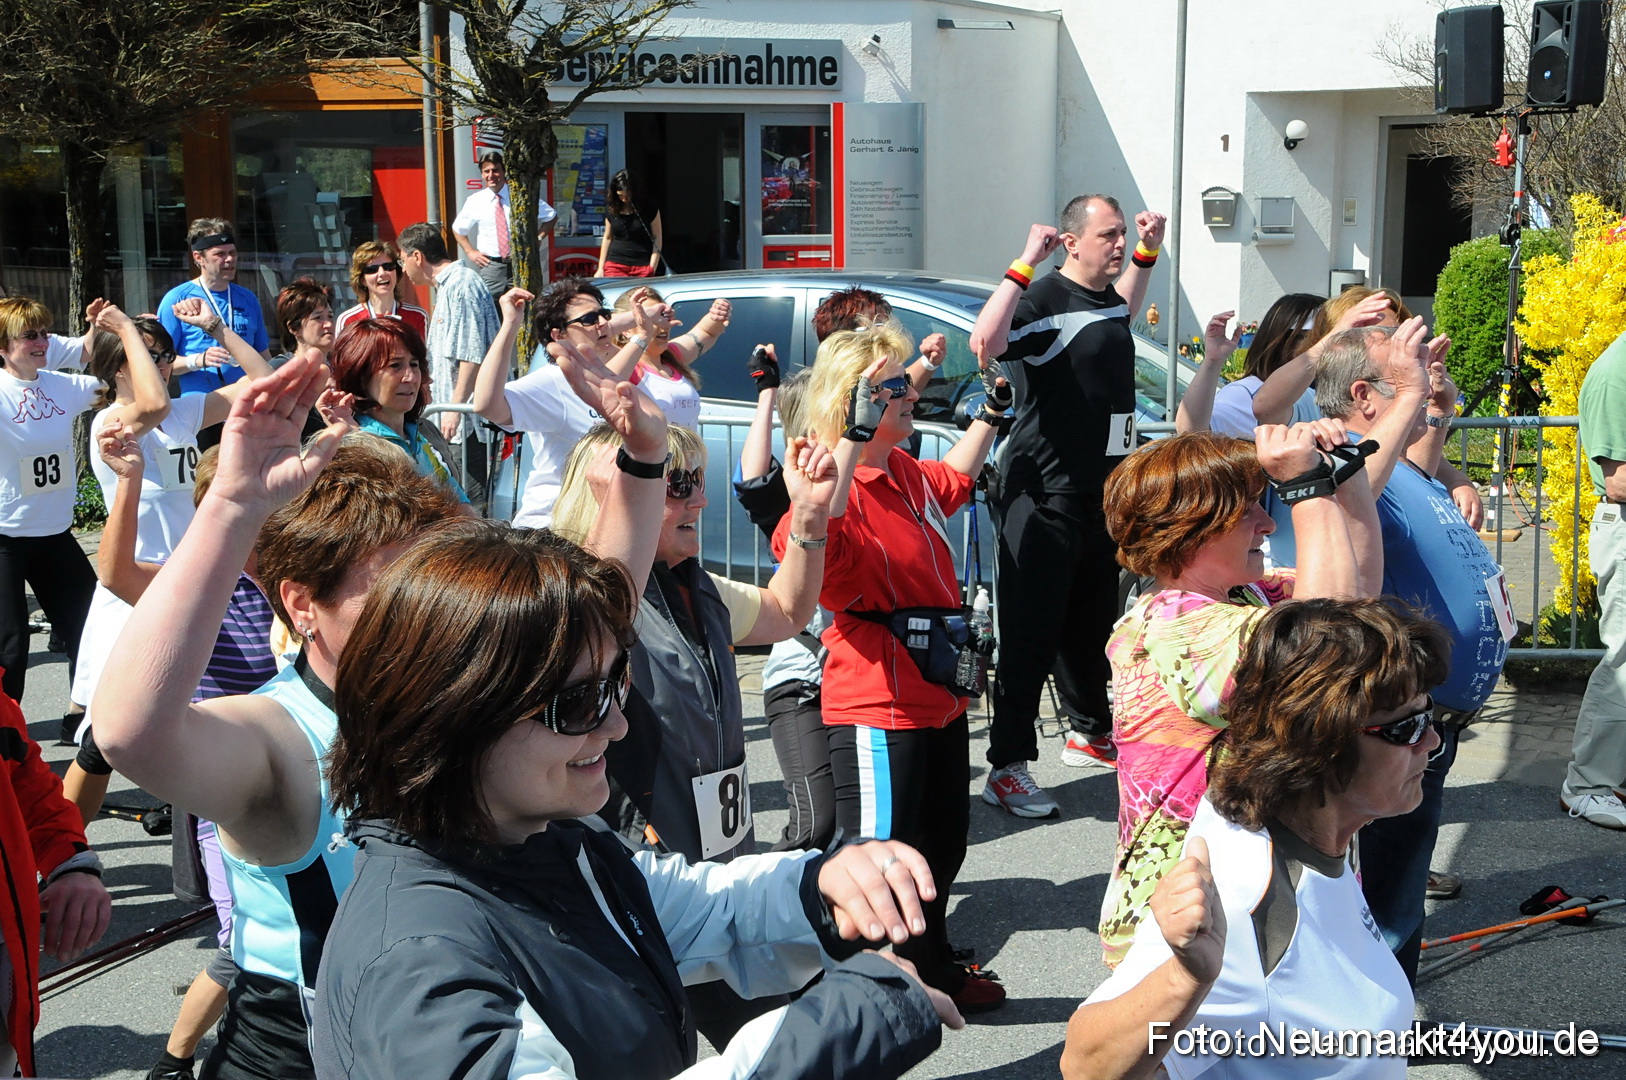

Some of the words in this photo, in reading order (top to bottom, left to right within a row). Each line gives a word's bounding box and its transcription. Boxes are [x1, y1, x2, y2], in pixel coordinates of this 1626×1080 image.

[1220, 134, 1230, 152] 1
[1123, 415, 1133, 449] 9
[33, 454, 61, 488] 93
[169, 446, 198, 484] 79
[1277, 486, 1316, 501] LEKI
